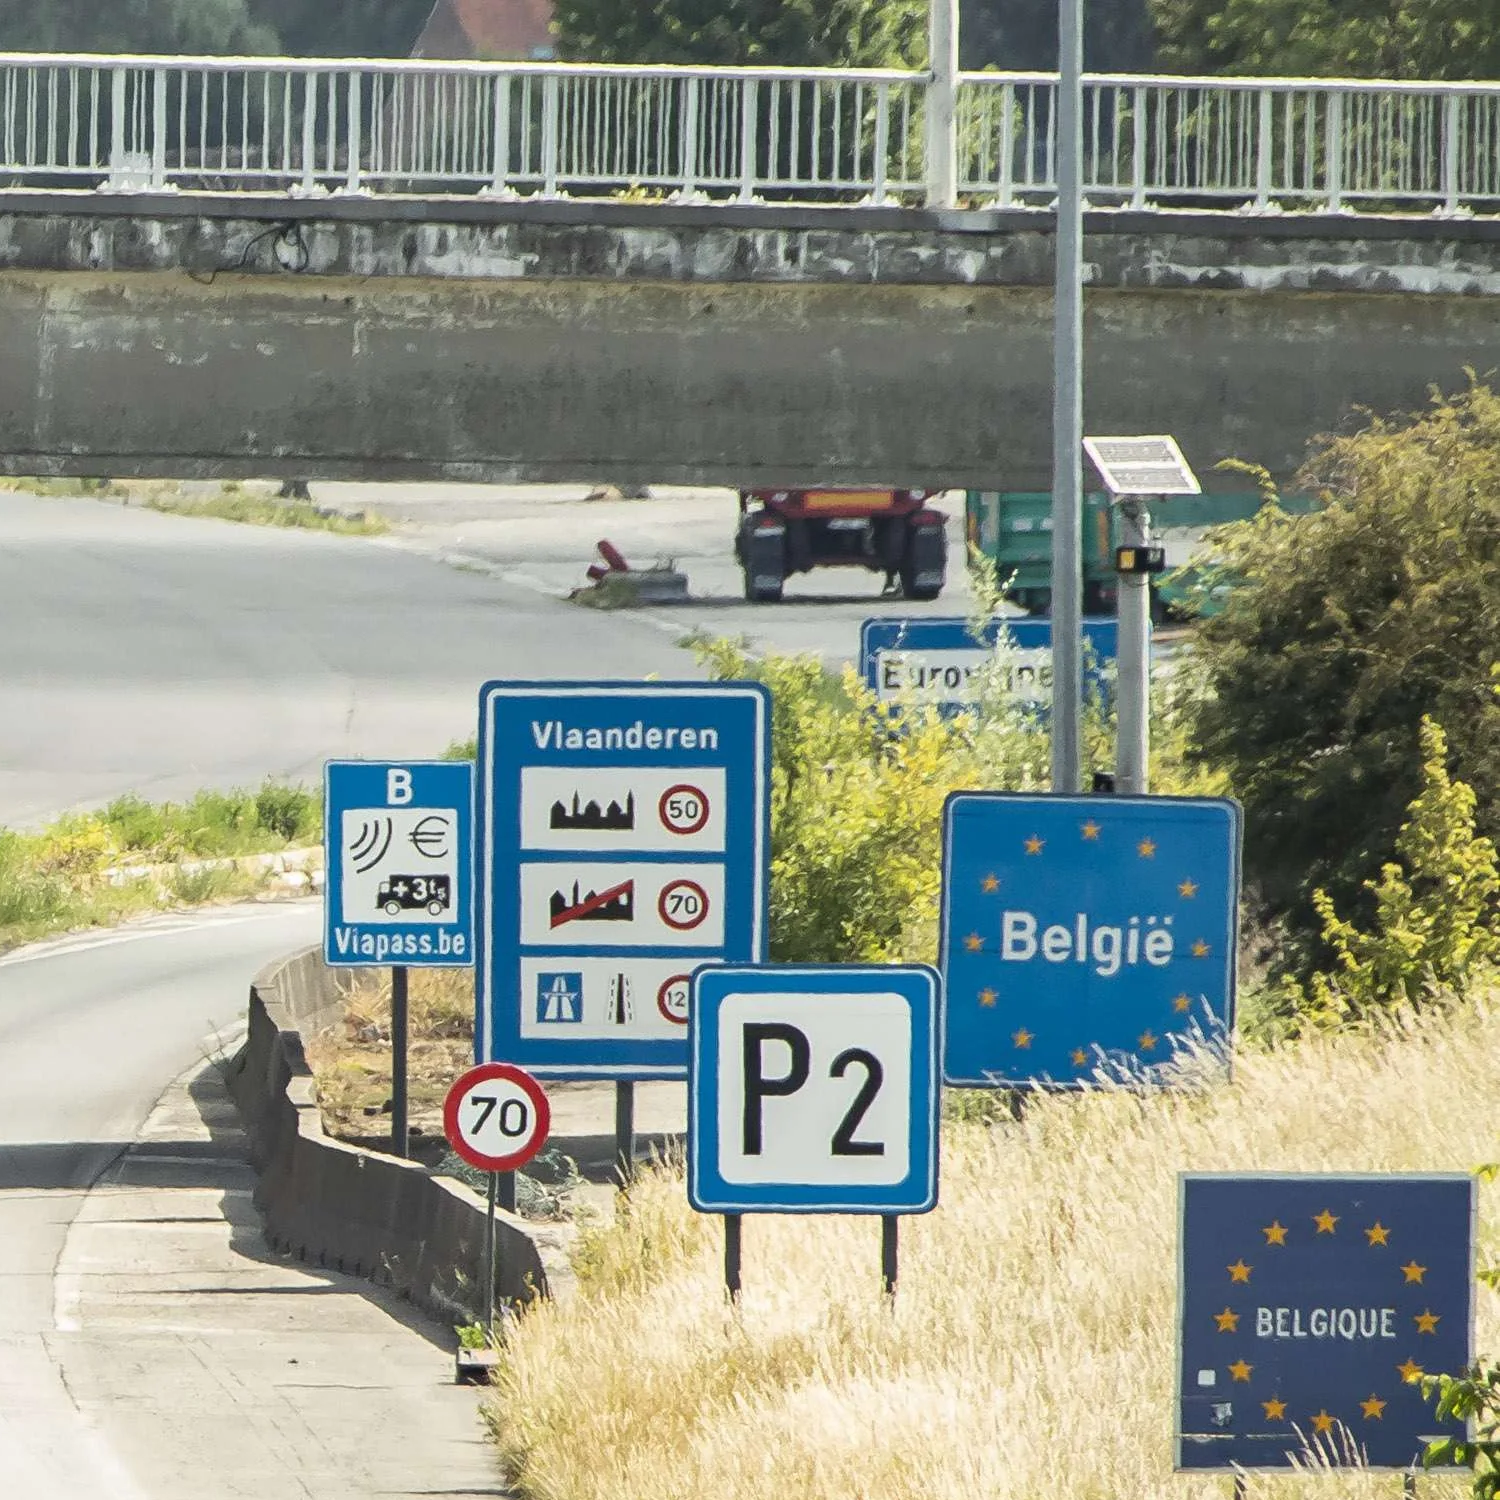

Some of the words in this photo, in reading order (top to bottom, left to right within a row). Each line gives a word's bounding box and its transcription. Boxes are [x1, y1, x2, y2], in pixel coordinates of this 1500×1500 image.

[531, 720, 719, 750] Vlaanderen
[386, 768, 413, 806] B
[669, 800, 699, 820] 50
[669, 894, 699, 915] 70
[334, 927, 466, 961] Viapass.be
[1001, 910, 1174, 977] België
[470, 1095, 528, 1138] 70
[1256, 1306, 1397, 1341] BELGIQUE
